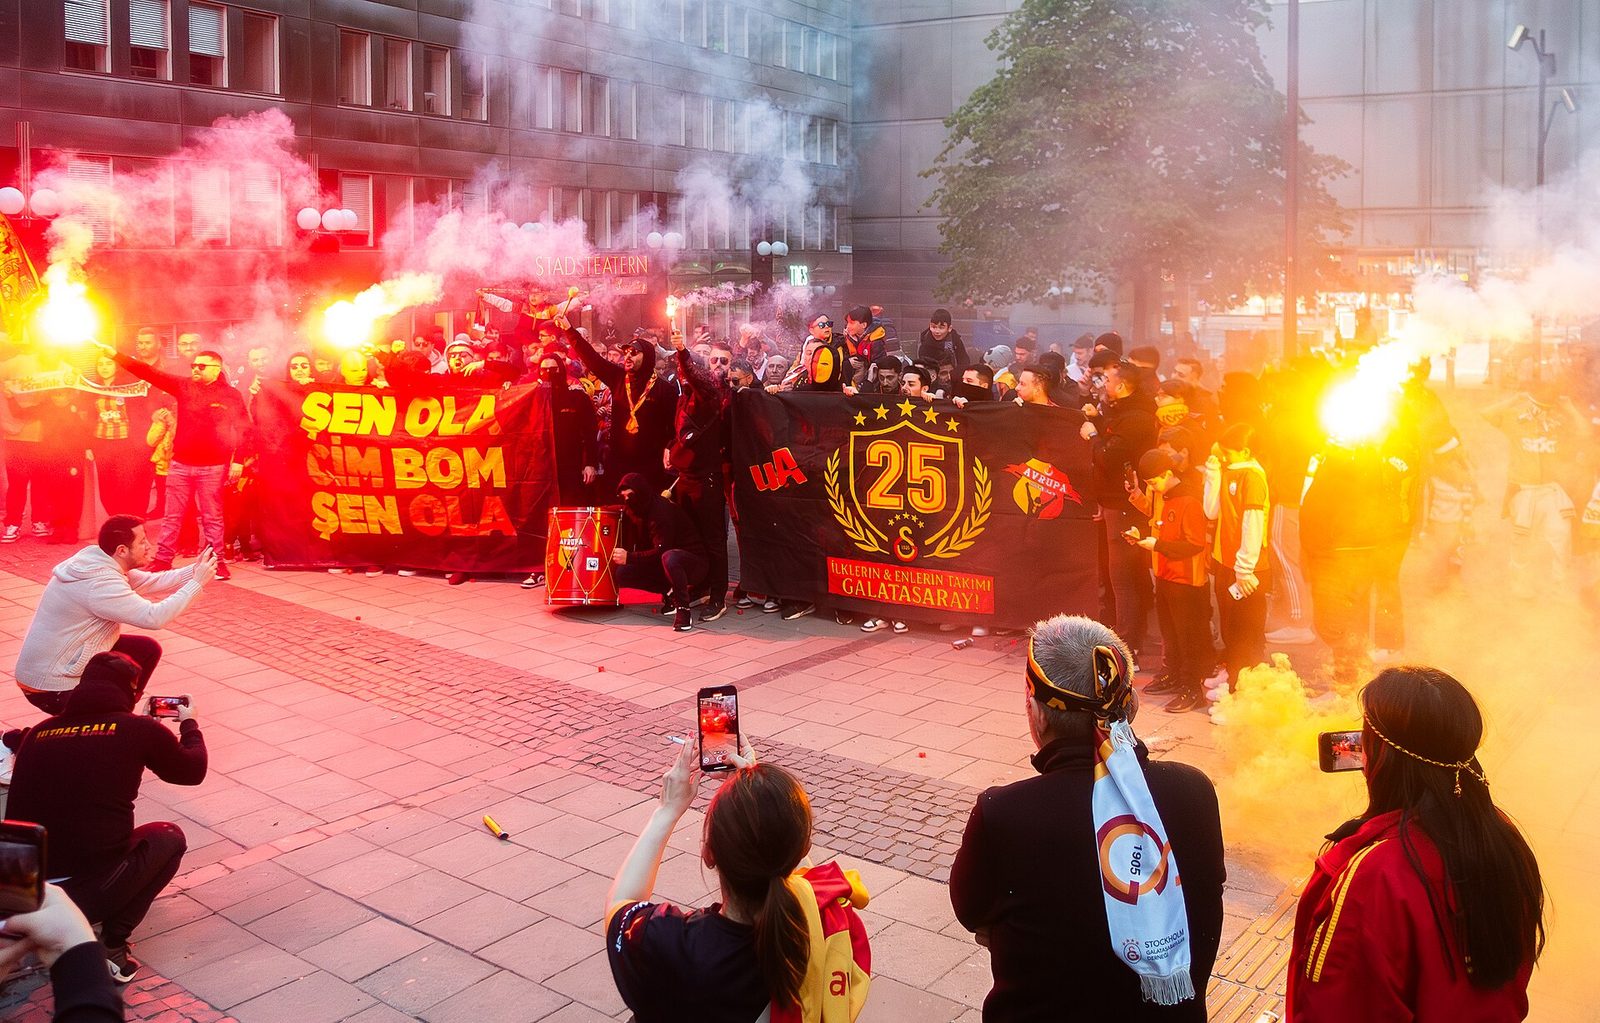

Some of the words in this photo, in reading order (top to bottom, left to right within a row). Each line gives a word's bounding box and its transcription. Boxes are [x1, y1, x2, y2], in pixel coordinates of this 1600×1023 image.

[535, 255, 648, 276] STADSTEATERN
[789, 265, 808, 286] TRES
[300, 391, 397, 441] ŞEN
[404, 395, 502, 437] OLA
[391, 446, 507, 489] BOM
[866, 439, 946, 513] 25
[1023, 467, 1067, 493] AVRUPA
[311, 491, 404, 541] ŞEN
[408, 494, 518, 537] OLA
[842, 577, 980, 611] GALATASARAY!
[883, 568, 892, 582] &
[949, 575, 992, 592] TAKIMI
[82, 723, 117, 737] GALA
[1130, 844, 1143, 876] 1905
[1144, 928, 1185, 949] STOCKHOLM
